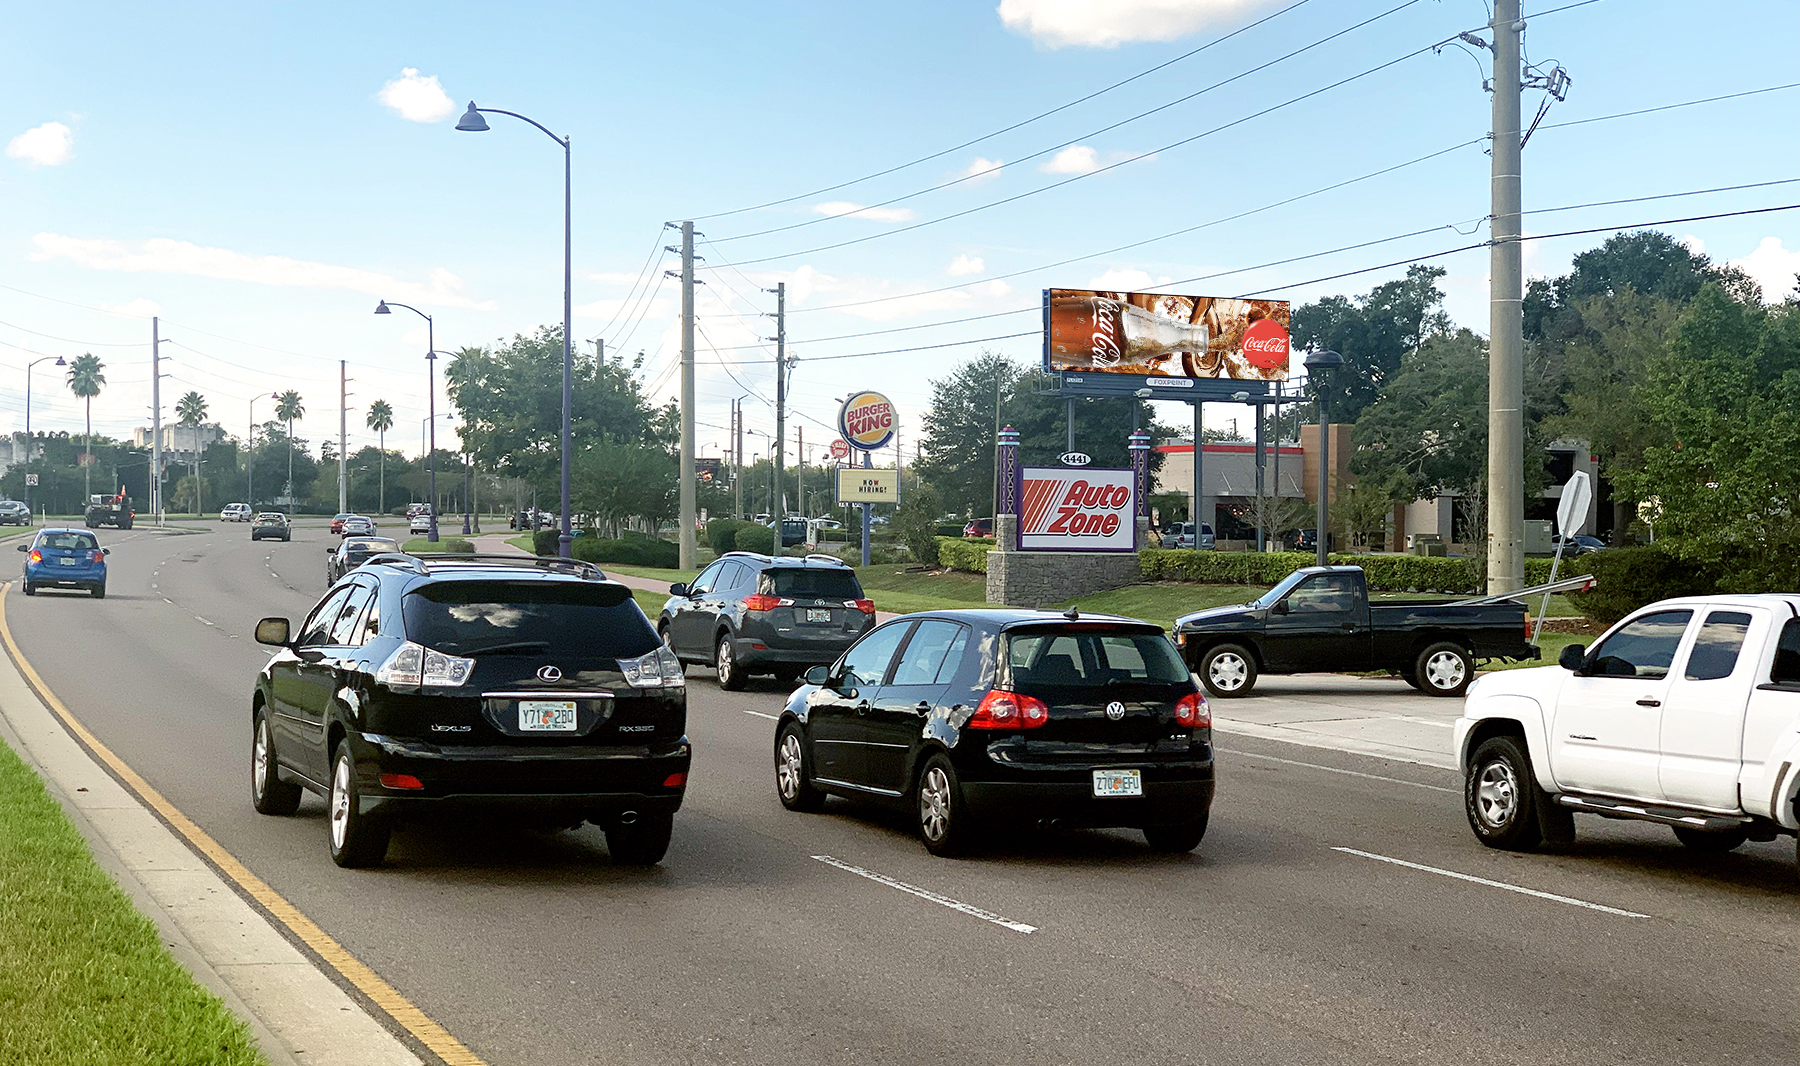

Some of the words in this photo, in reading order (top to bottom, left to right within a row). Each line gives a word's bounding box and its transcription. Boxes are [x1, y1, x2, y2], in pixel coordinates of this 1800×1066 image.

[1091, 296, 1121, 368] Coca-Cola
[1243, 336, 1288, 353] Coca-Cola
[847, 403, 890, 423] BURGER
[849, 413, 892, 437] KING
[1063, 454, 1088, 463] 4441
[1061, 479, 1131, 509] Auto
[1047, 507, 1119, 535] Zone
[523, 709, 541, 724] Y71
[554, 709, 574, 724] 2BQ
[431, 724, 471, 732] LEXUS
